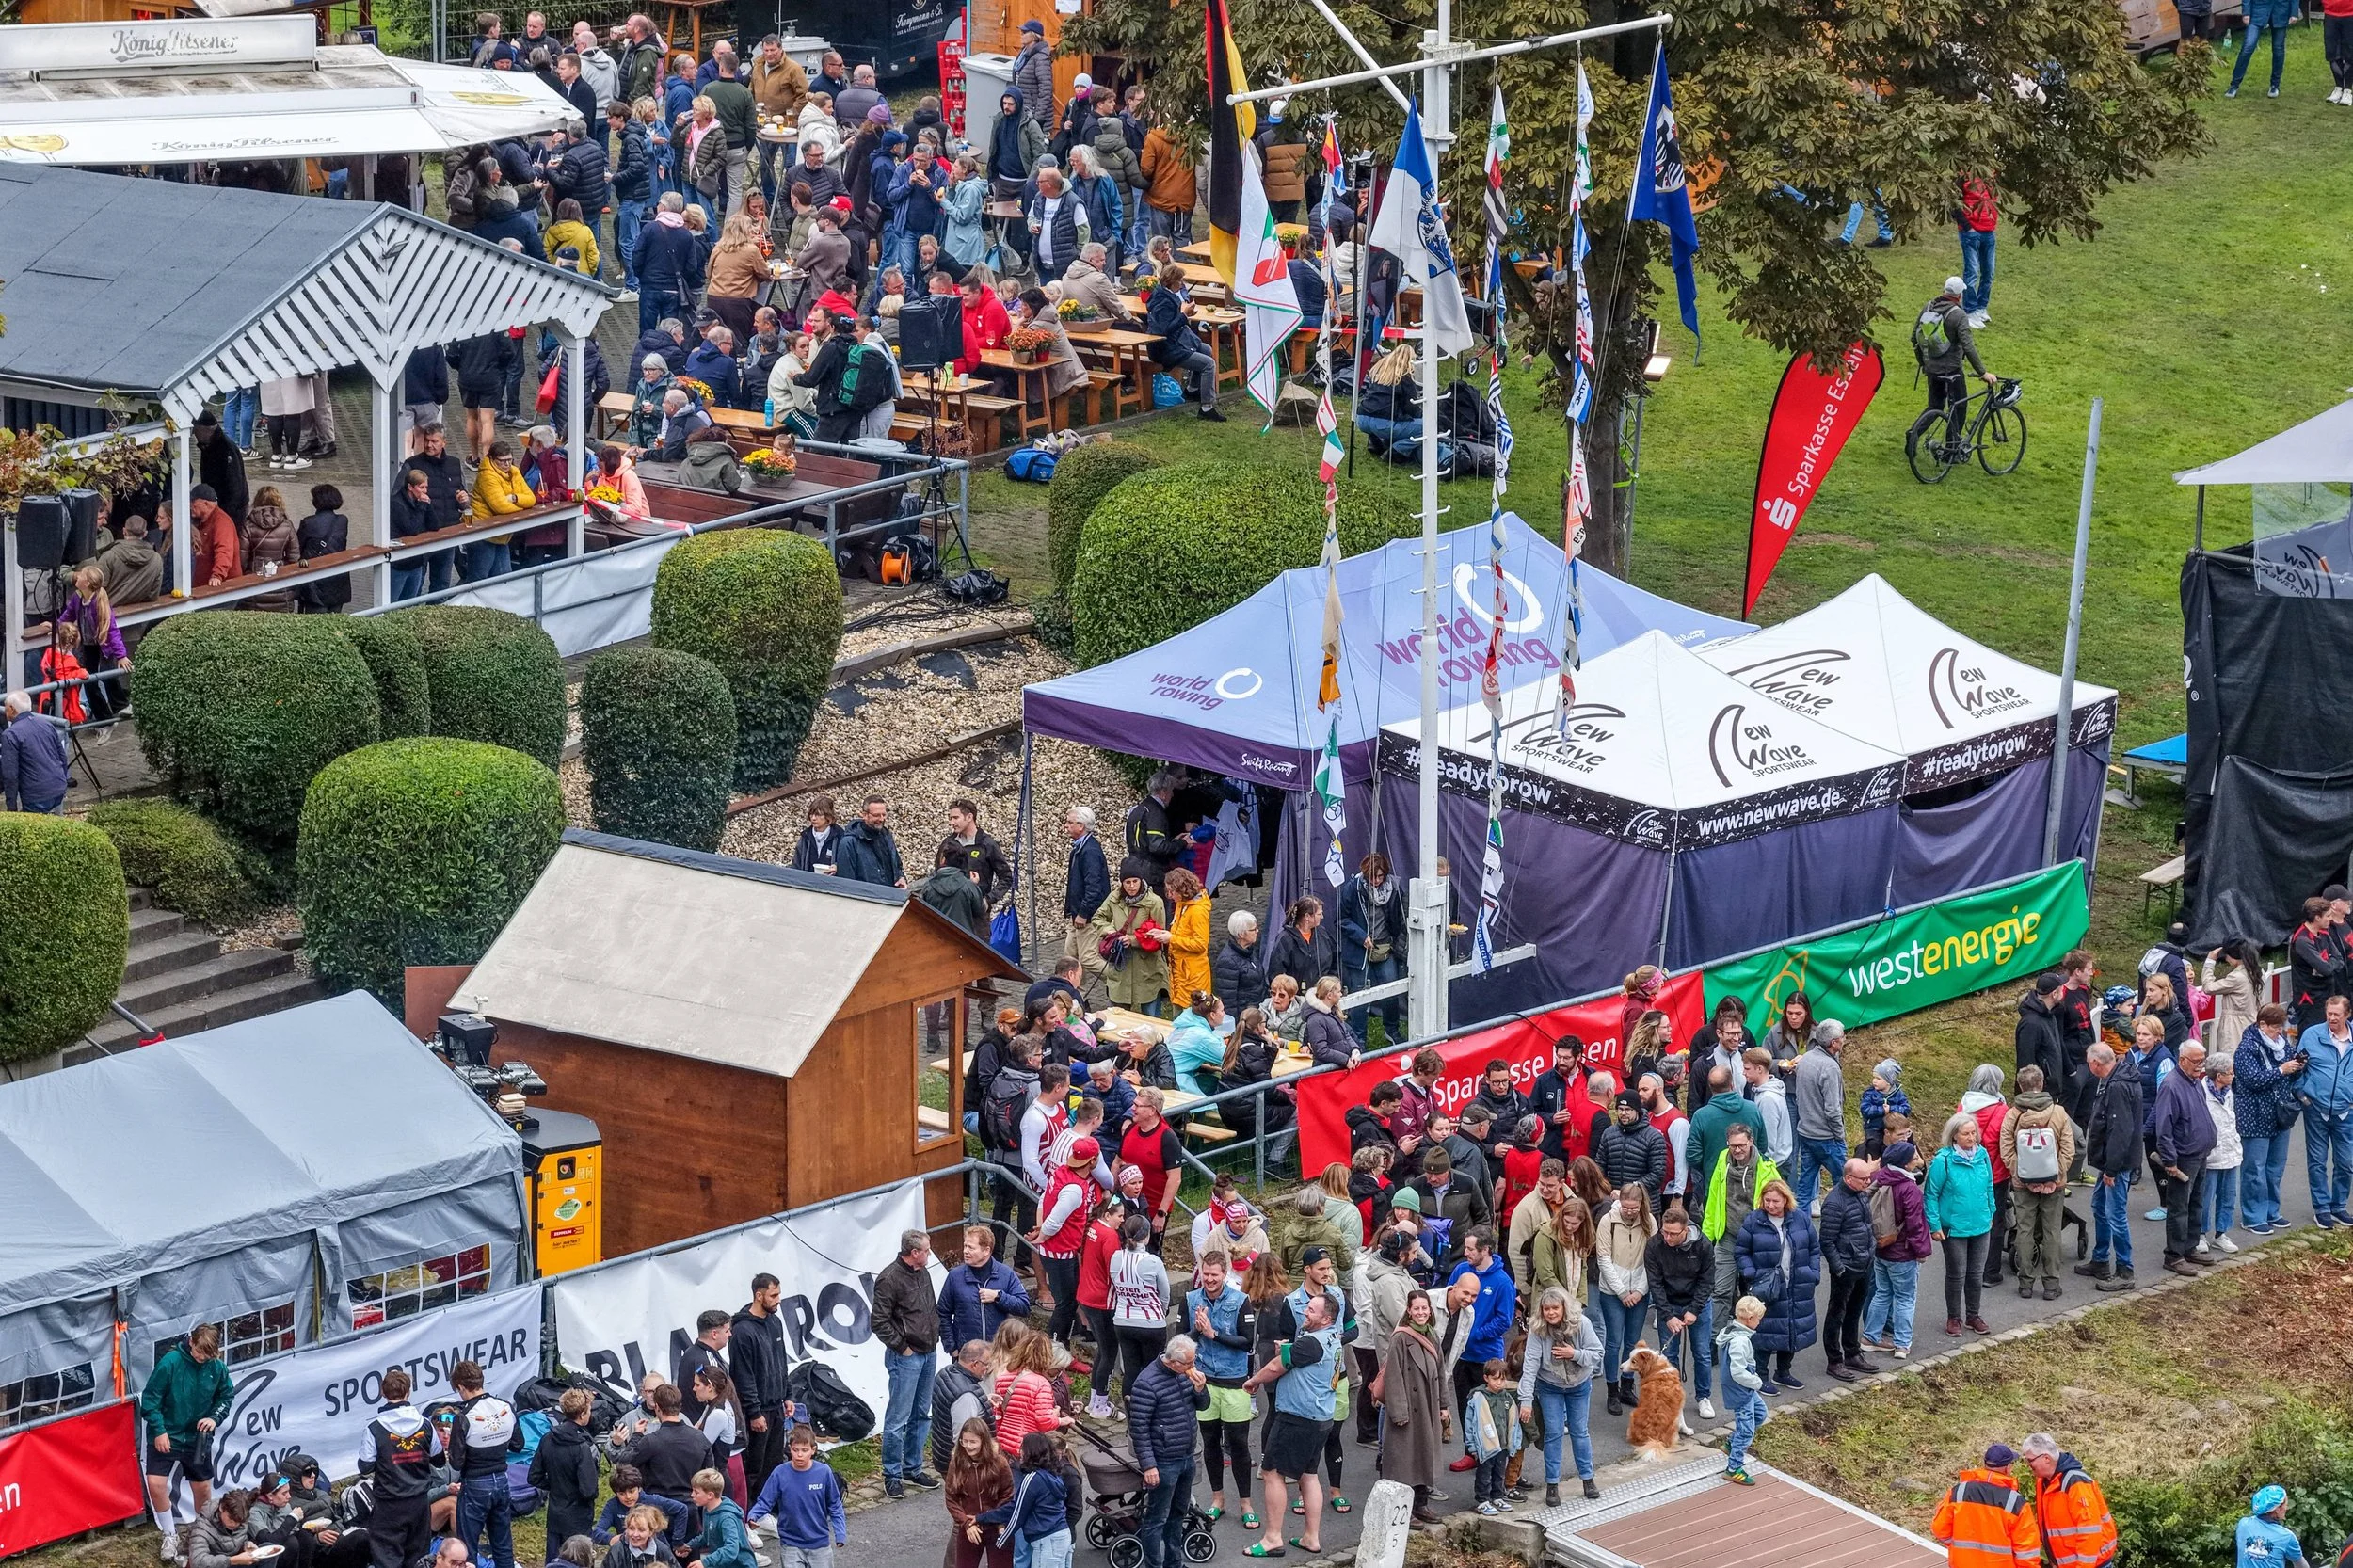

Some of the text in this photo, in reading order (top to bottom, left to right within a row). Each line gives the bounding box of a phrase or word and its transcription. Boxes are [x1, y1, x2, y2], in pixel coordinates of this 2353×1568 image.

[109, 29, 168, 58] König
[1787, 402, 1838, 498] Sparkasse
[1150, 672, 1214, 691] world
[1149, 685, 1225, 711] rowing
[1964, 685, 2022, 712] Wave
[1970, 698, 2032, 720] SPORTSWEAR
[1241, 753, 1297, 776] Swift Racing
[1510, 744, 1593, 775] SPORTSWEAR
[1743, 743, 1807, 770] Wave
[1751, 758, 1817, 778] SPORTSWEAR
[1922, 733, 2028, 778] #readytorow
[1697, 787, 1841, 837] www.newwave.de
[1848, 905, 2041, 998] westenergie
[1432, 1053, 1545, 1112] Sparsse
[1391, 1503, 1409, 1527] 22
[1392, 1533, 1399, 1548] 5
